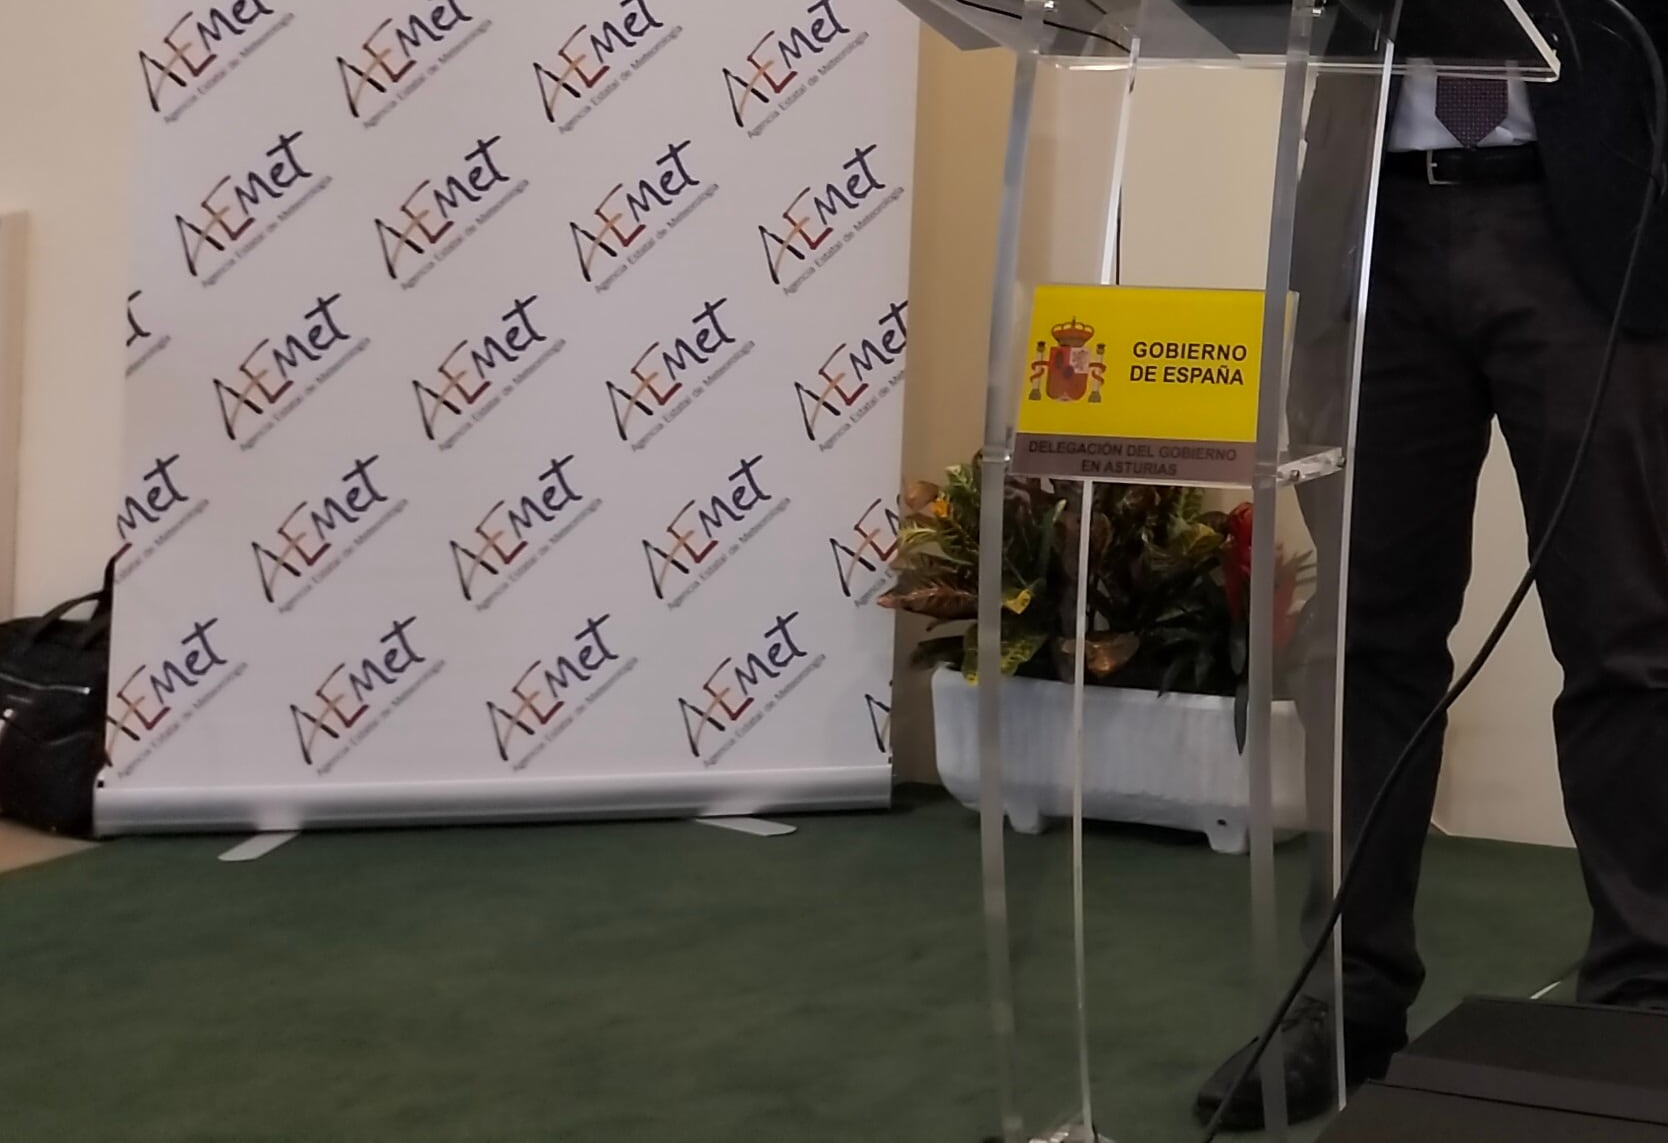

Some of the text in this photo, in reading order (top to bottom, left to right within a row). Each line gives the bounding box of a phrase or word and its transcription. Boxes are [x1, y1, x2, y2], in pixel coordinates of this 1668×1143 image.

[1132, 341, 1248, 362] GOBIERNO
[1129, 364, 1245, 385] DE ESPAÑA
[1028, 439, 1238, 461] DELEGACIÓN DEL GOBIERNO
[1081, 459, 1178, 475] EN ASTURIAS
